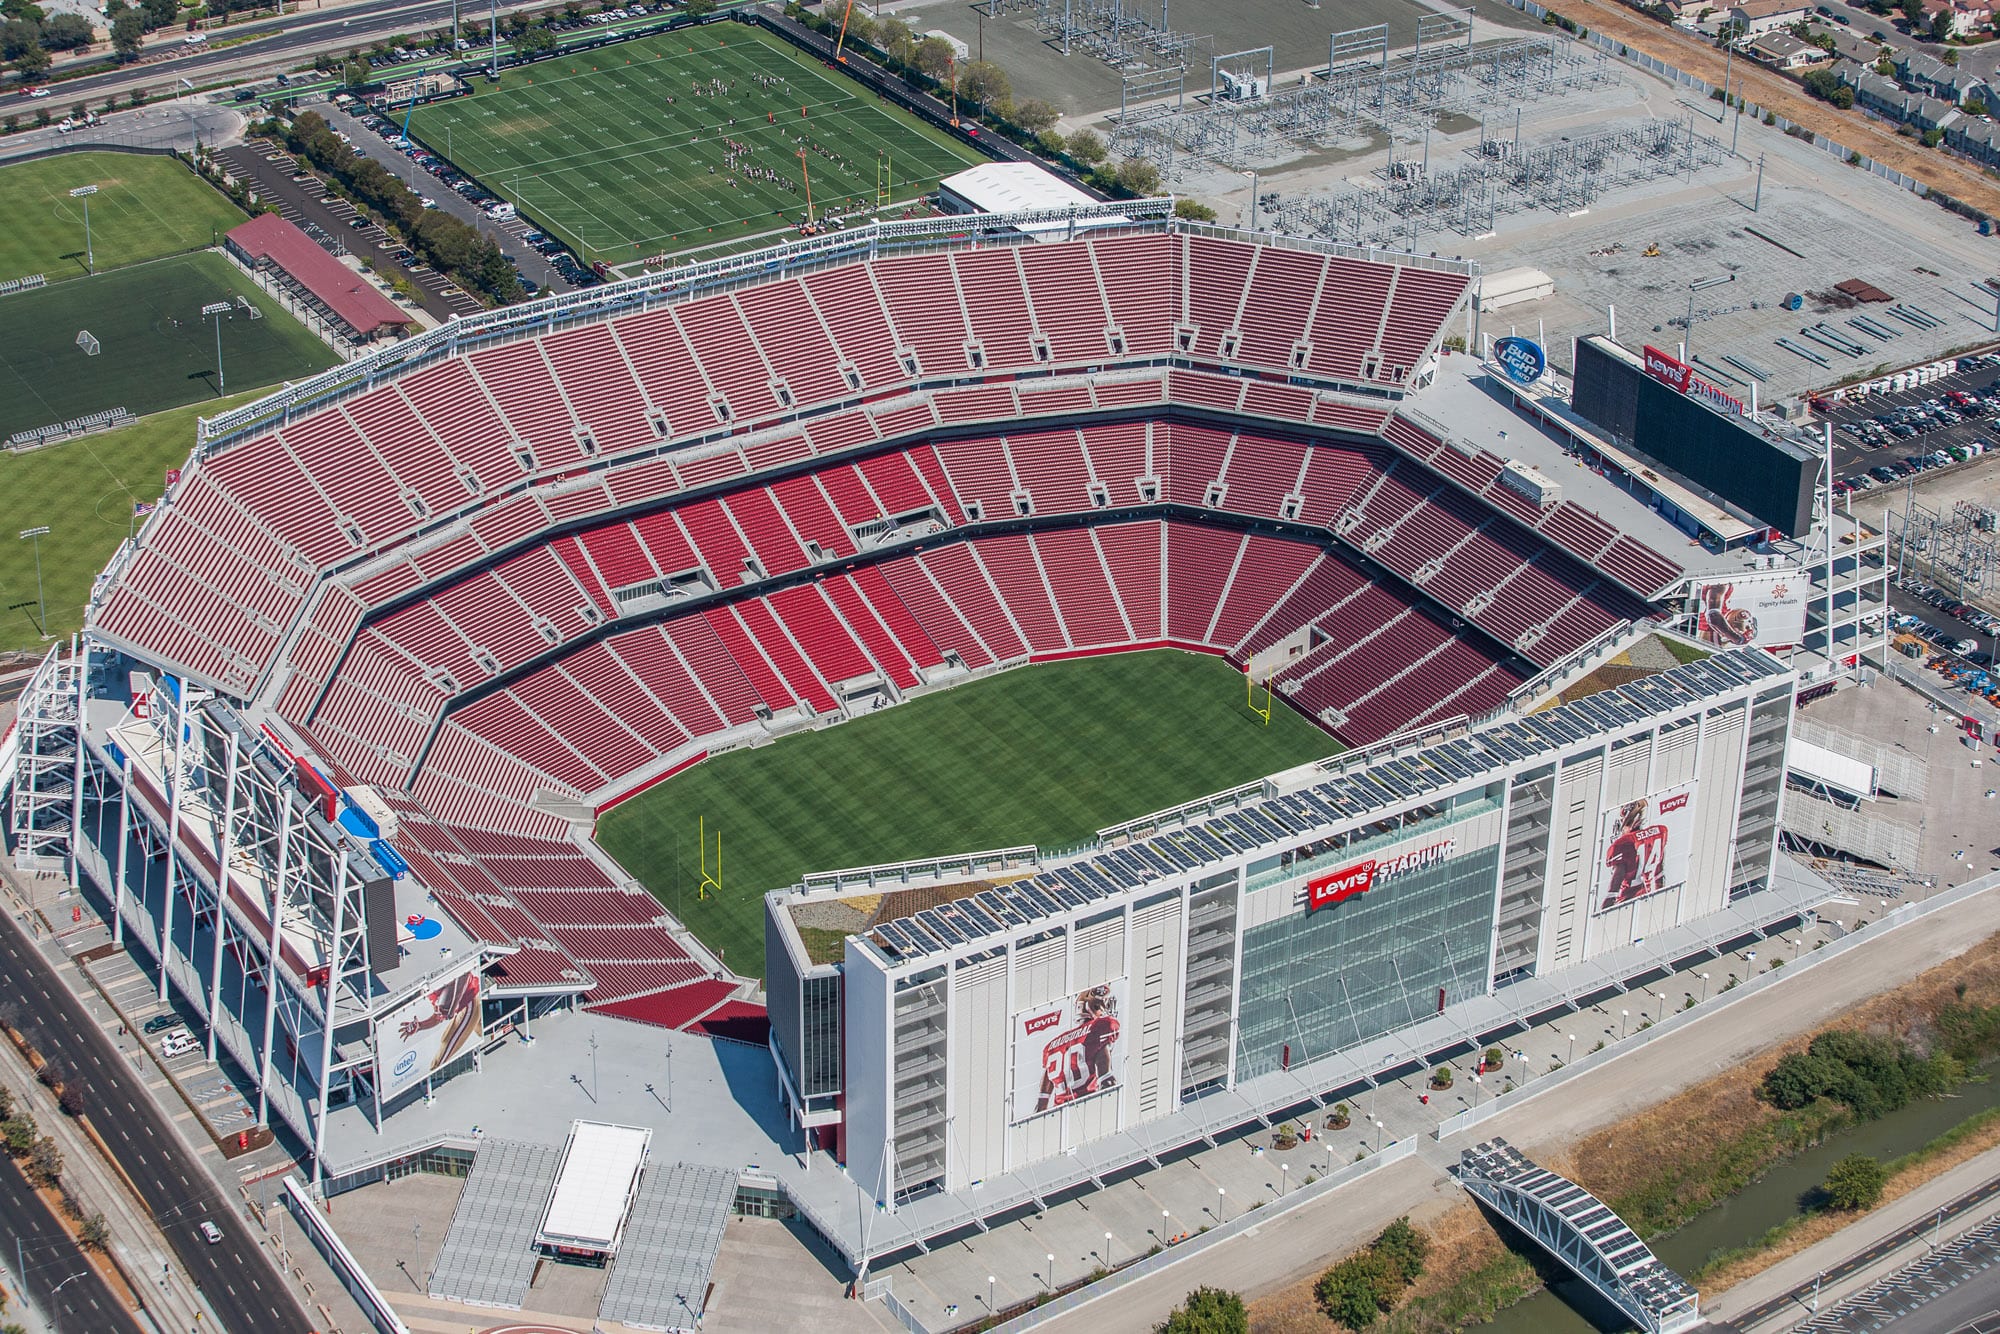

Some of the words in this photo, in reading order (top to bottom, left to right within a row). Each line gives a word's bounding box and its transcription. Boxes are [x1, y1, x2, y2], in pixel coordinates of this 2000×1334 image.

[1499, 350, 1539, 376] LIGHT
[1507, 344, 1536, 366] BUD
[1689, 377, 1743, 415] STADIUM
[1379, 840, 1452, 878] STADIUM
[1632, 838, 1662, 893] 14
[396, 1054, 415, 1071] intel
[1046, 1043, 1090, 1095] 20
